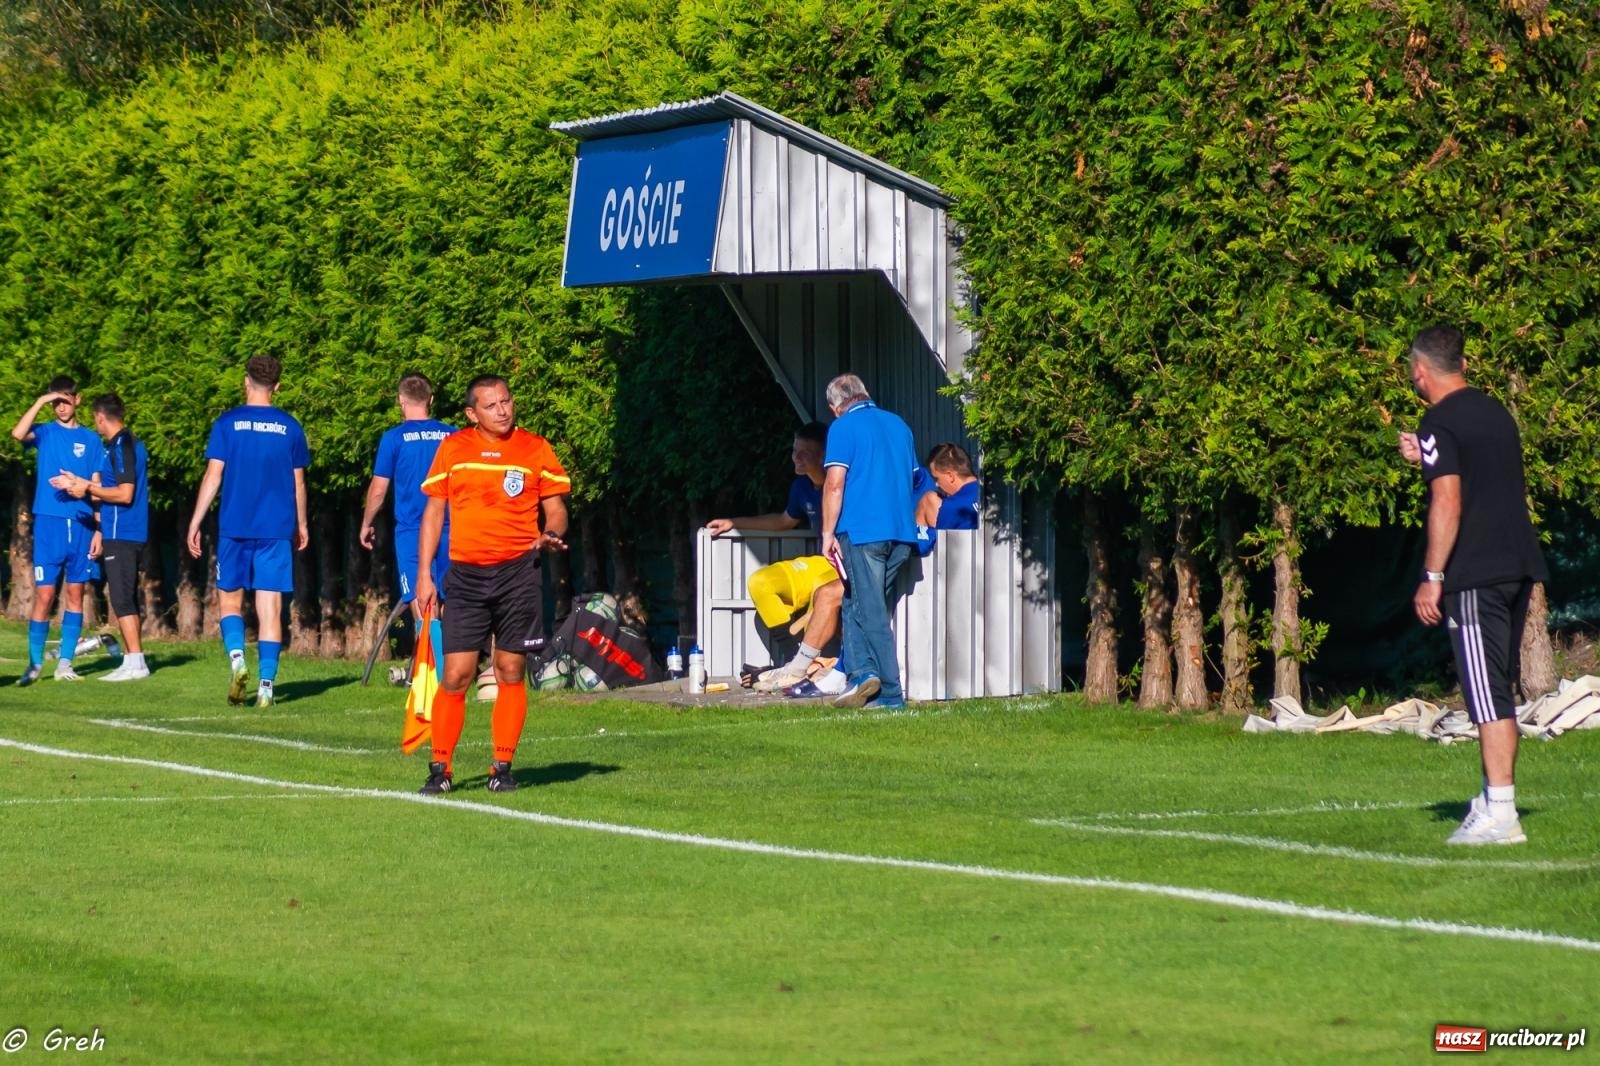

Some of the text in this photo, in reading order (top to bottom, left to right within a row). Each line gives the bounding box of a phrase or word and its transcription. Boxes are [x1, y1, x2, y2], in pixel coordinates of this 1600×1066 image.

[600, 164, 686, 252] GOŚCIE
[234, 420, 287, 435] UNIA RACIBÓRZ
